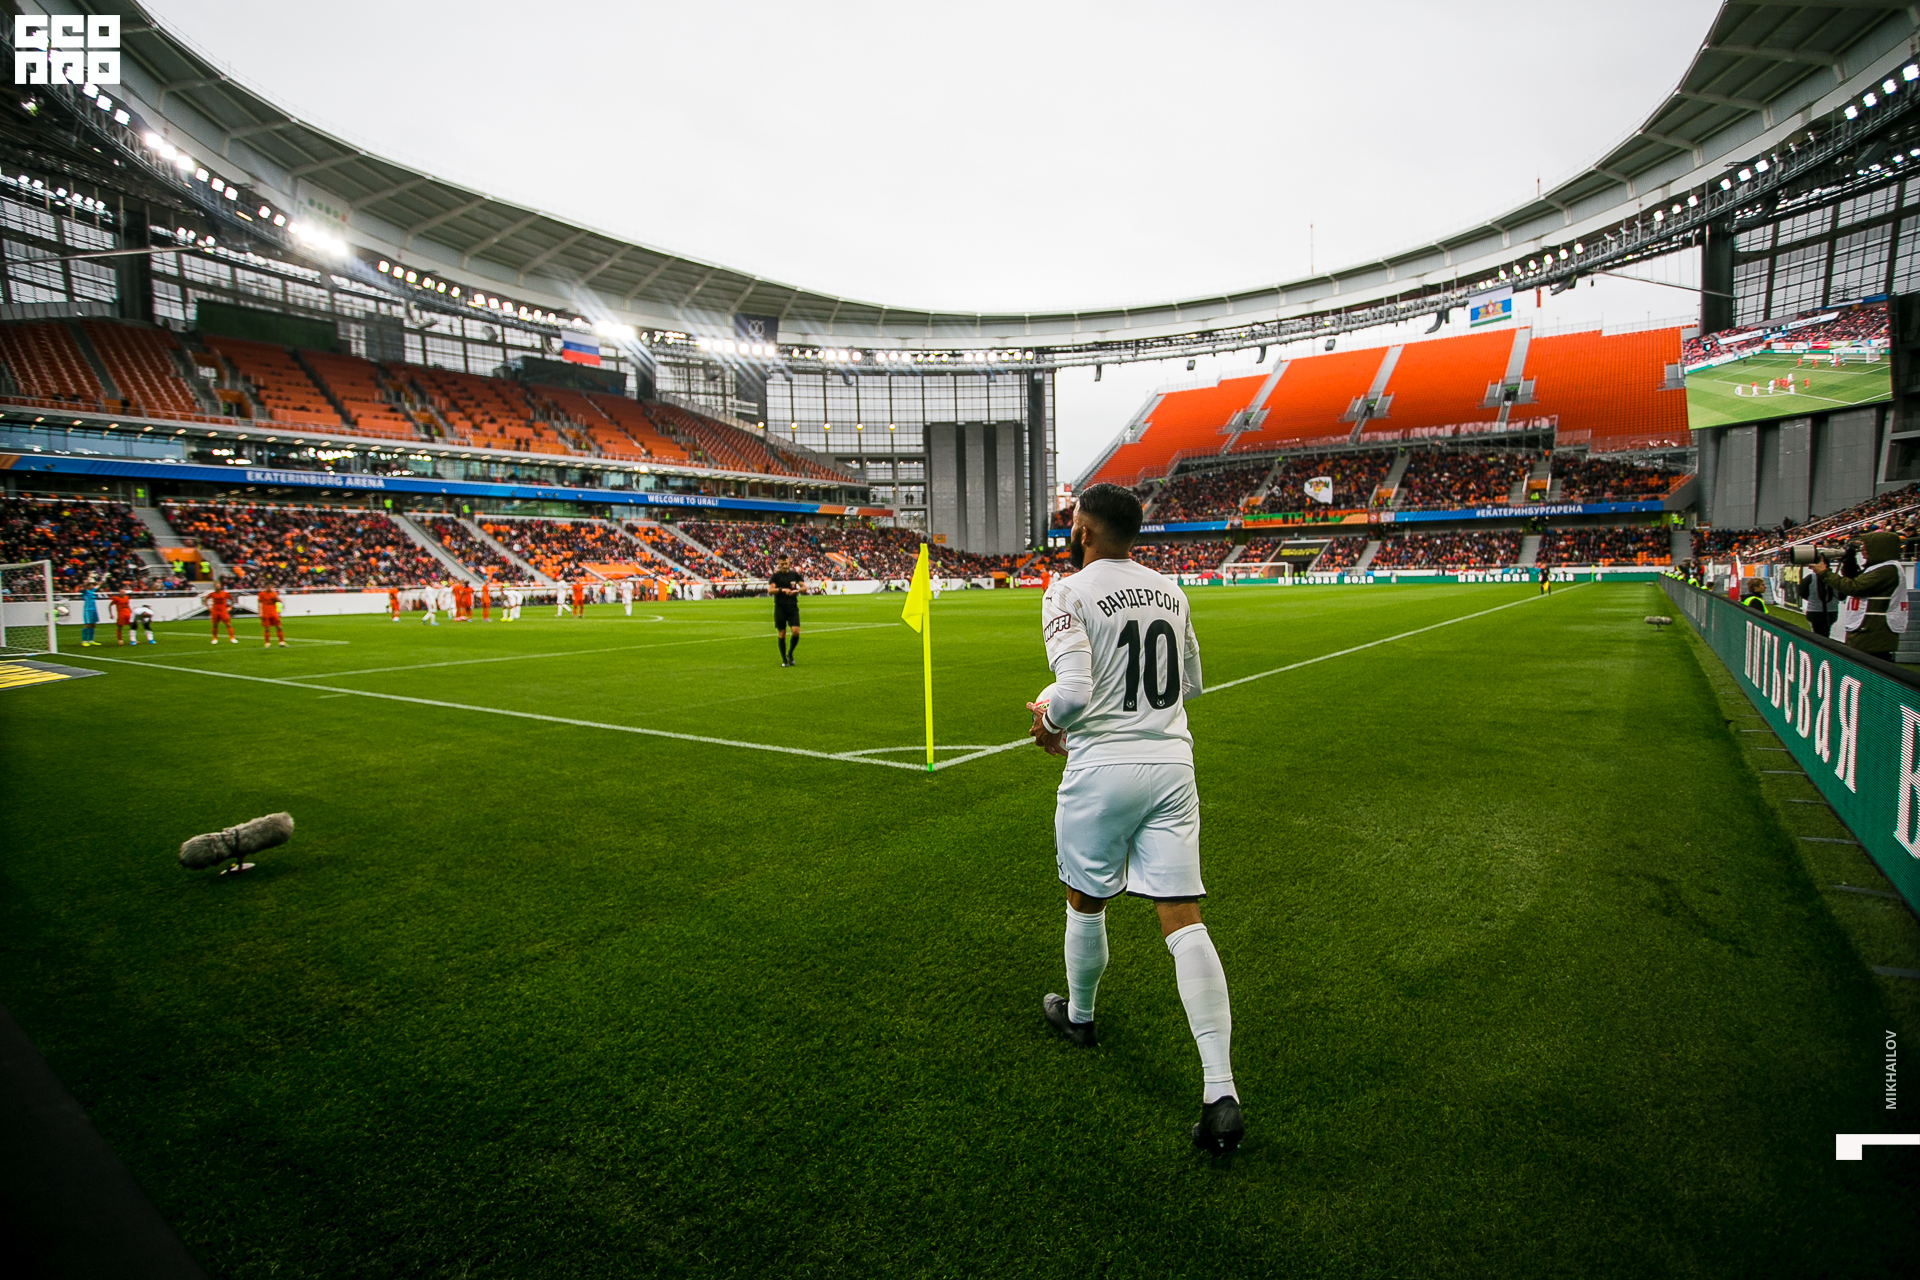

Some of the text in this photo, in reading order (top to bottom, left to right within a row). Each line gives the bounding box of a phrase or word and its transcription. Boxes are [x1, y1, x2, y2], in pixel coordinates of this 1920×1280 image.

[246, 471, 386, 488] EKATERINBURG ARENA
[647, 494, 719, 506] WELCOME TO URAL!
[1476, 505, 1584, 518] #ЕКАТЕРИНБУРГАРЕНА
[1097, 588, 1180, 618] ВАНДЕРСОН
[1117, 619, 1180, 712] 10
